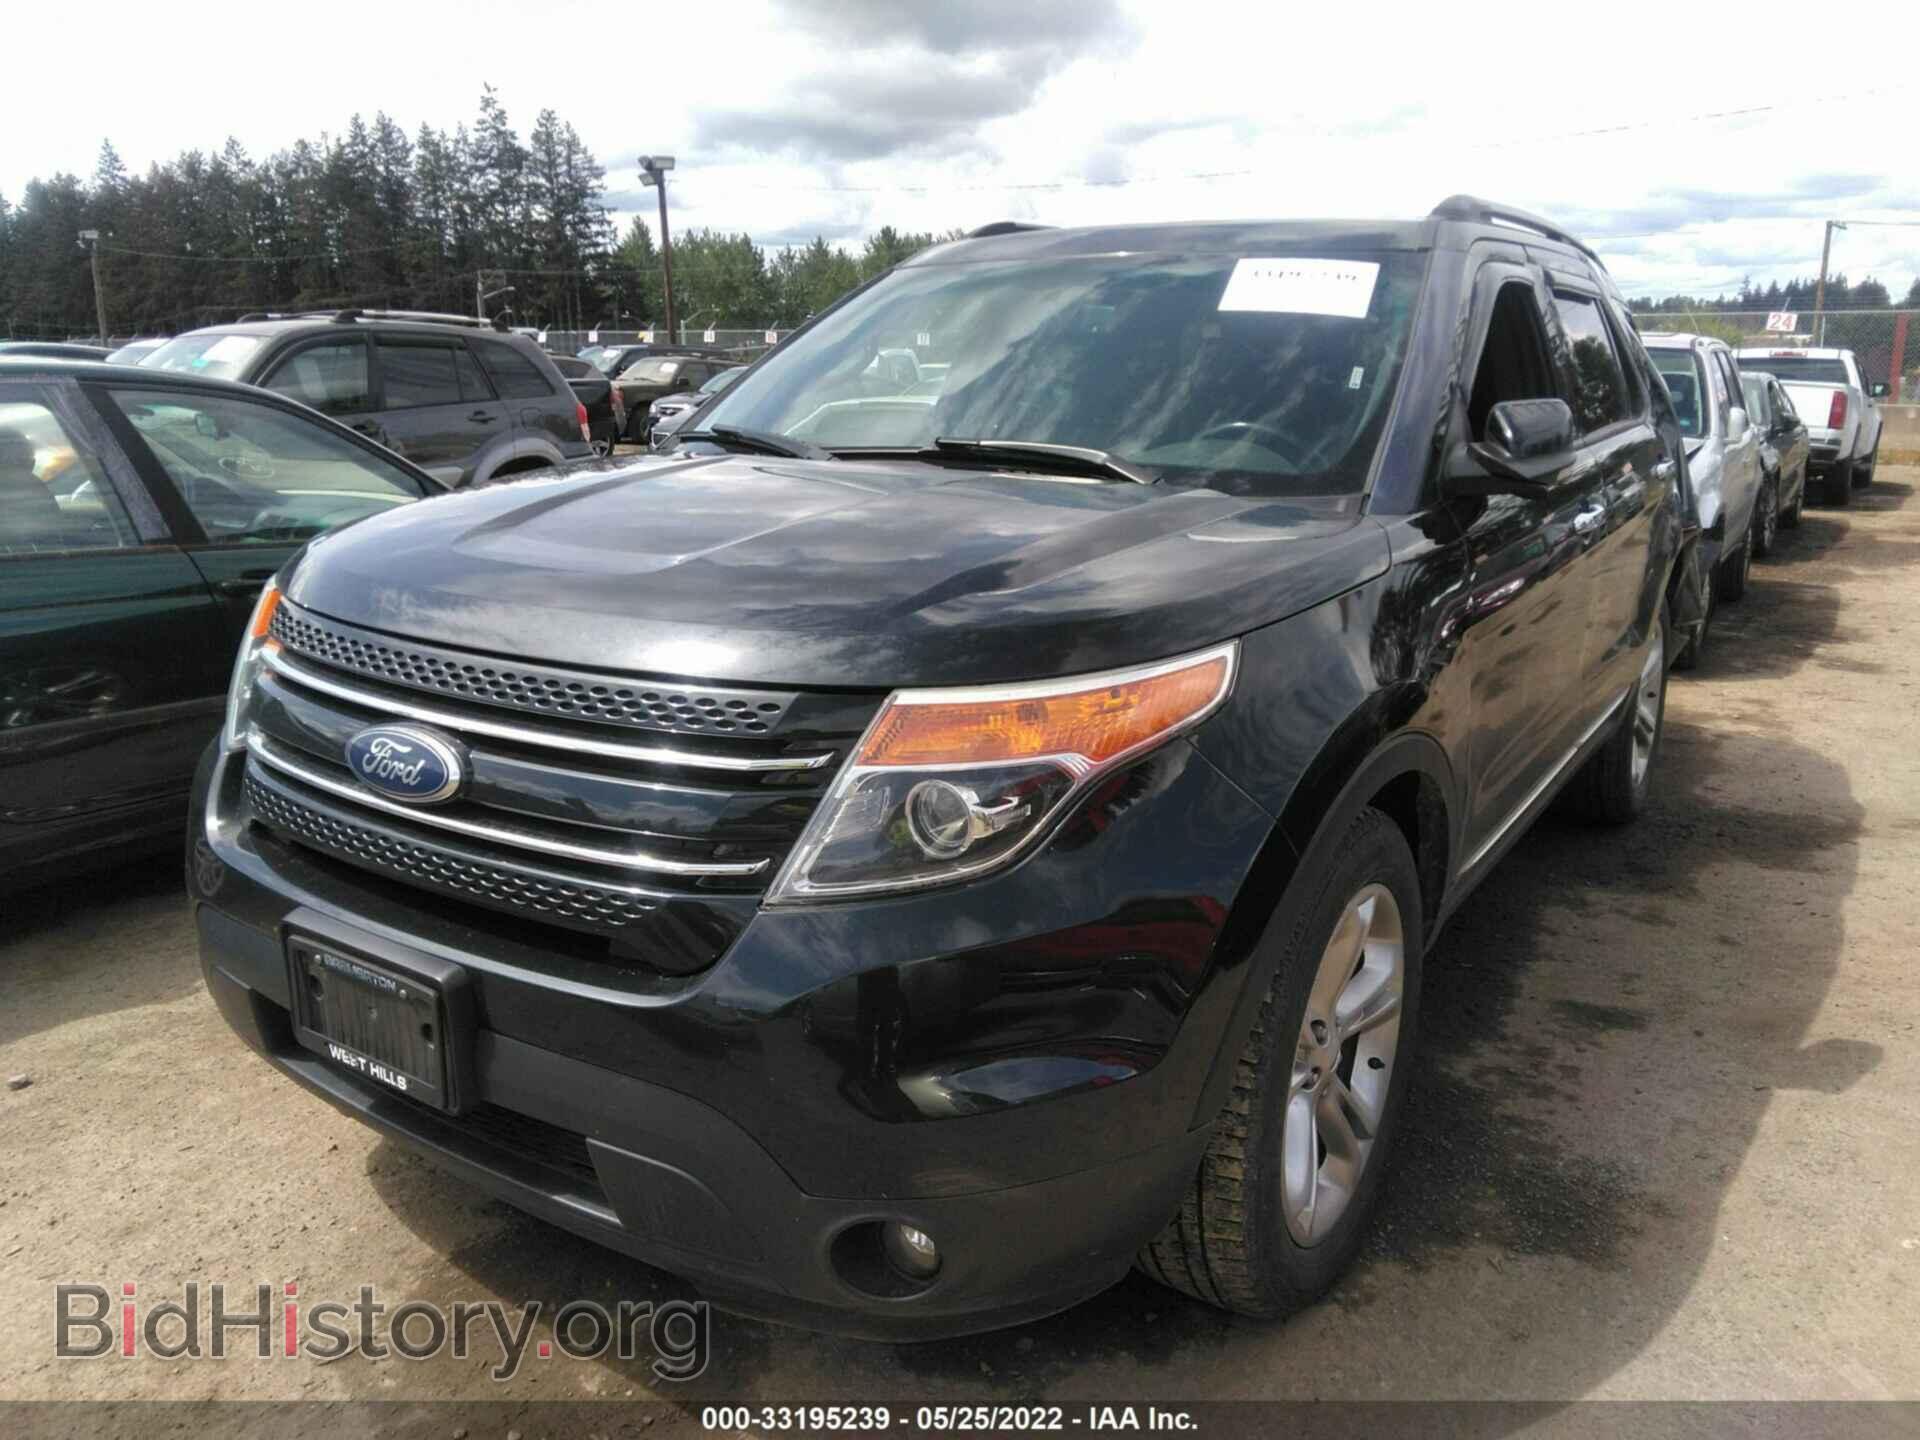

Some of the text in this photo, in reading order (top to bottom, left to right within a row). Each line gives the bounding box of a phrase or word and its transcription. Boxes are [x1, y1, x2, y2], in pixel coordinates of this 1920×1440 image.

[1769, 313, 1794, 330] 24
[362, 737, 425, 786] Ford
[369, 1061, 408, 1091] HILLS
